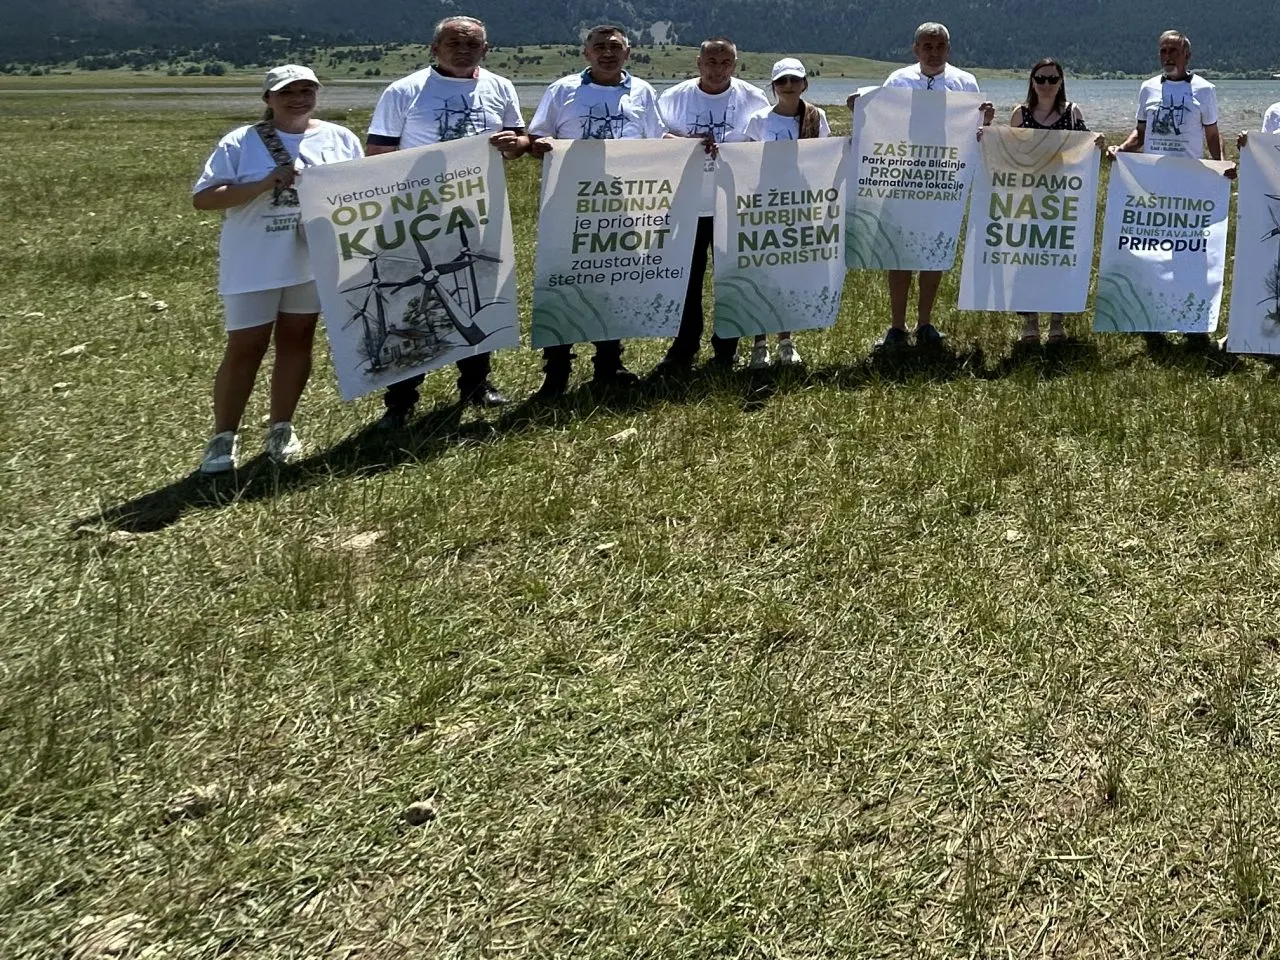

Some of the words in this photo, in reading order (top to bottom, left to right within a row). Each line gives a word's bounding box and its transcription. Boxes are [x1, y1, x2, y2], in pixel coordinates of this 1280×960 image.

[872, 141, 958, 159] ZAŠTITITE
[861, 155, 886, 165] Park
[887, 157, 927, 168] prirode
[928, 159, 966, 171] Blidinje
[869, 166, 957, 181] PRONAĐITE
[992, 172, 1017, 187] NE
[1021, 173, 1083, 191] DAMO
[326, 176, 430, 207] Vjetroturbine
[434, 165, 482, 184] daleko
[577, 176, 673, 197] ZAŠTITA
[857, 187, 873, 198] ZA
[858, 177, 924, 189] alternativne
[925, 179, 964, 192] lokacije
[331, 200, 382, 226] OD
[390, 176, 485, 215] NAŠIH
[576, 196, 672, 213] BLIDINJA
[736, 193, 763, 209] NE
[767, 187, 839, 207] ŽELIMO
[988, 187, 1080, 222] NAŠE
[1124, 192, 1216, 212] ZAŠTITIMO
[574, 216, 592, 233] je
[597, 212, 671, 232] prioritet
[736, 206, 822, 227] TURBINE
[827, 204, 840, 219] U
[1122, 210, 1212, 229] BLIDINJE
[338, 197, 490, 261] KUĆA!
[737, 221, 840, 252] NAŠEM
[985, 215, 1076, 250] ŠUME
[1120, 225, 1134, 235] NE
[1136, 225, 1211, 238] UNIŠTAVAJMO
[571, 228, 671, 254] FMOIT
[1118, 235, 1207, 252] PRIRODU!
[571, 253, 663, 270] zaustavite
[737, 245, 839, 269] DVORIŠTU!
[990, 250, 1077, 267] STANIŠTA!
[548, 272, 605, 287] štetne
[610, 266, 684, 286] projekte!
